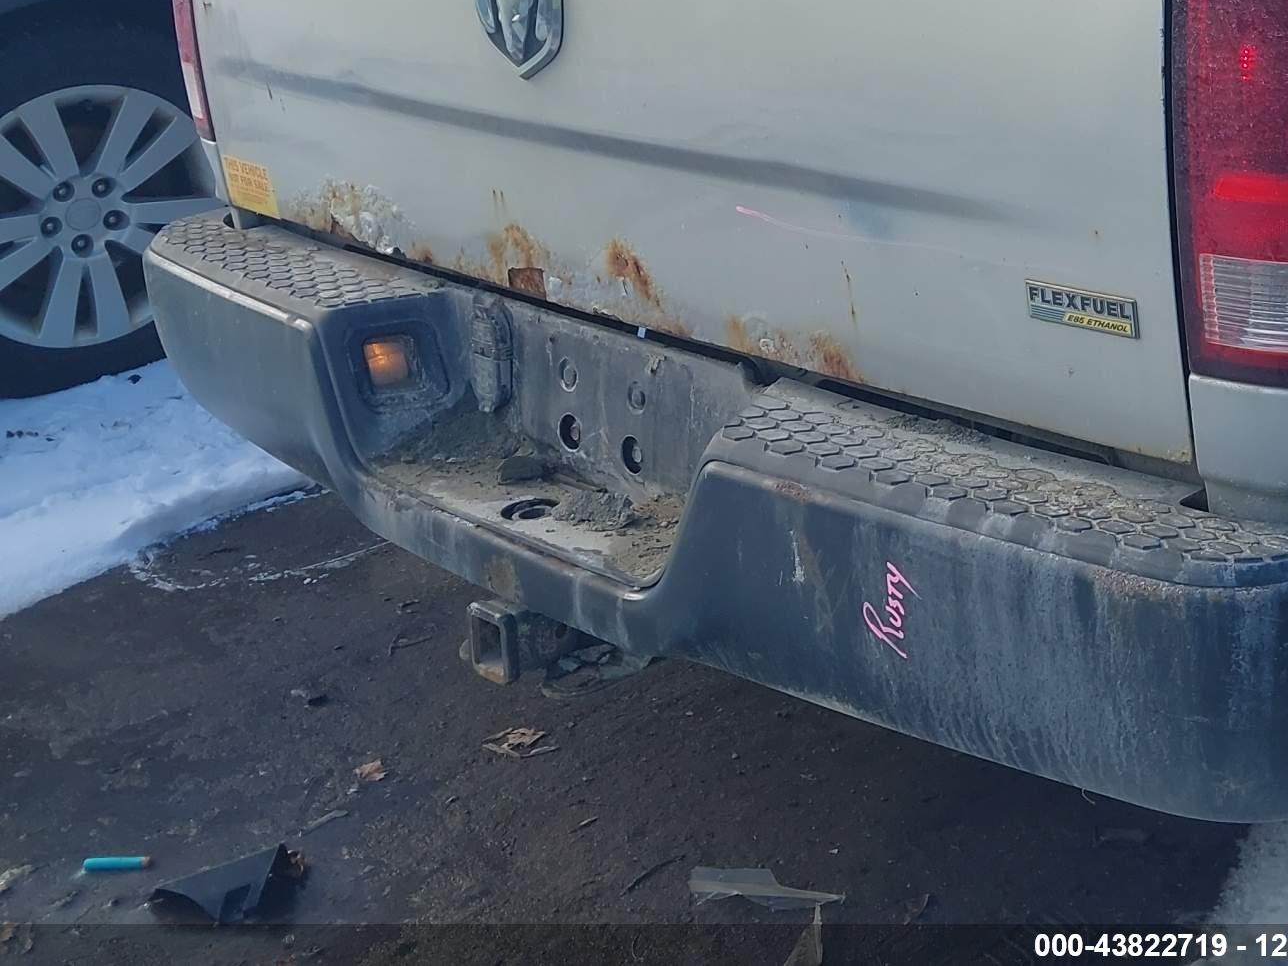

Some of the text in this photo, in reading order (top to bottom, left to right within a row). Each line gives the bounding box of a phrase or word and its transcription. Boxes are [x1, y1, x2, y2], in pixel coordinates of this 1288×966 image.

[1028, 286, 1132, 320] FLEXFUEL
[1066, 314, 1129, 333] E85 ETHANOL
